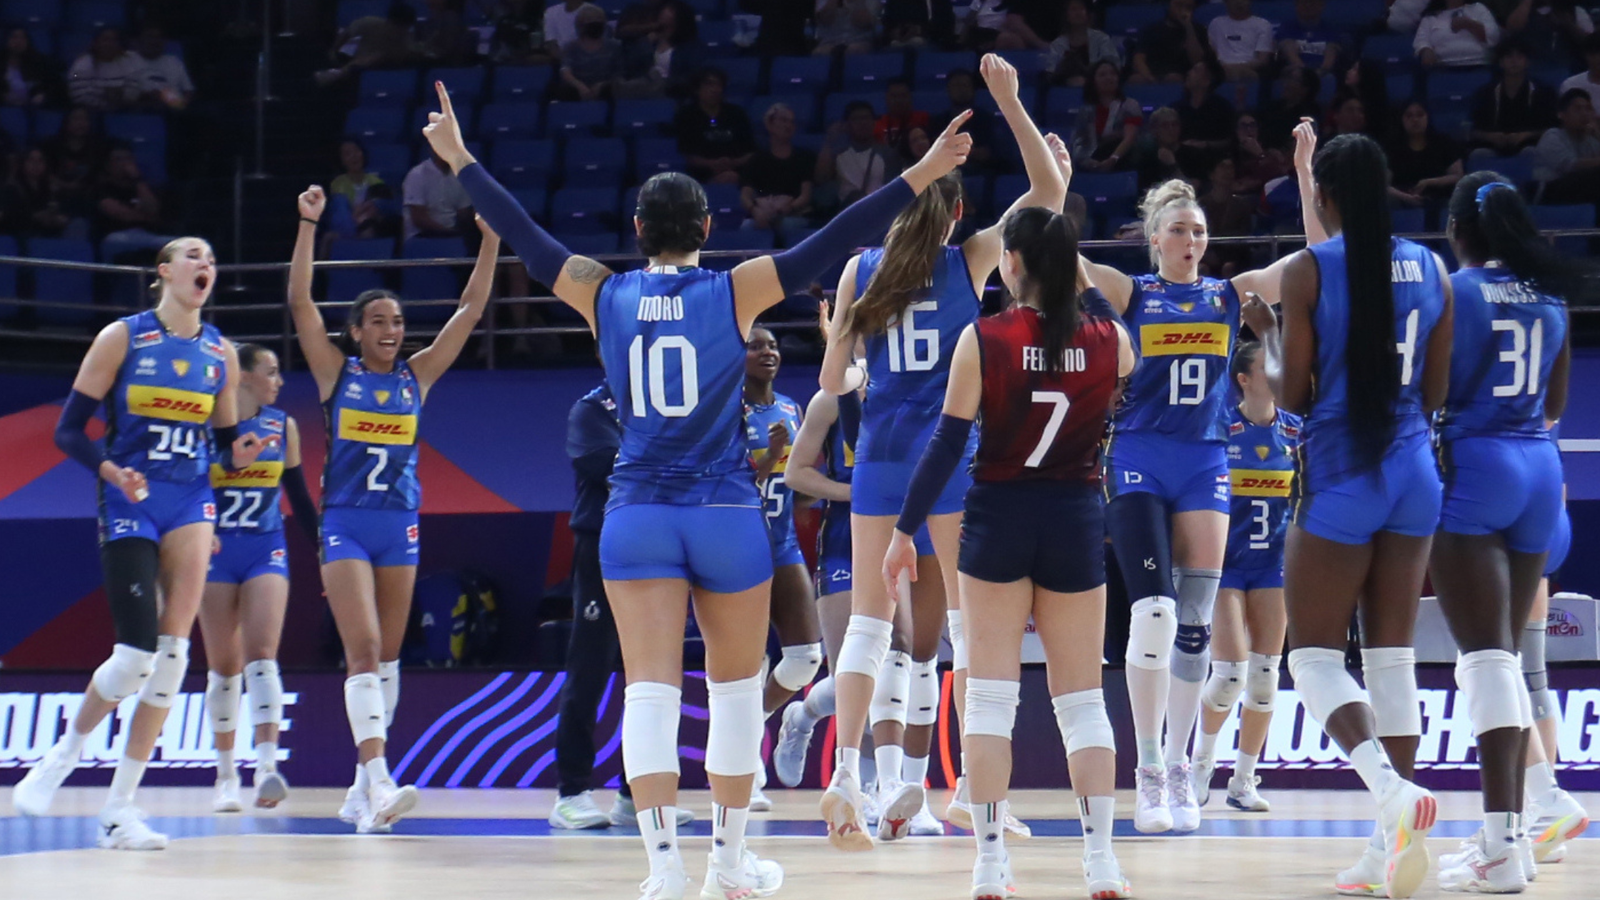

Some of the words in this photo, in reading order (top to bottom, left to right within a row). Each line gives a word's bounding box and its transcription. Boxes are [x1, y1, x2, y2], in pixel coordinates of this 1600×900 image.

[636, 295, 684, 322] MORO
[886, 301, 940, 373] 16
[1162, 333, 1214, 345] DHL
[629, 335, 699, 418] 10
[1022, 346, 1086, 373] FERNO
[1492, 318, 1543, 397] 31
[1169, 359, 1206, 405] 19
[151, 397, 204, 415] DHL
[147, 425, 197, 460] 24
[356, 421, 404, 435] DHL
[1024, 391, 1071, 468] 7
[366, 447, 389, 491] 2
[1241, 478, 1286, 489] DHL
[218, 490, 263, 529] 22
[1250, 500, 1270, 541] 3
